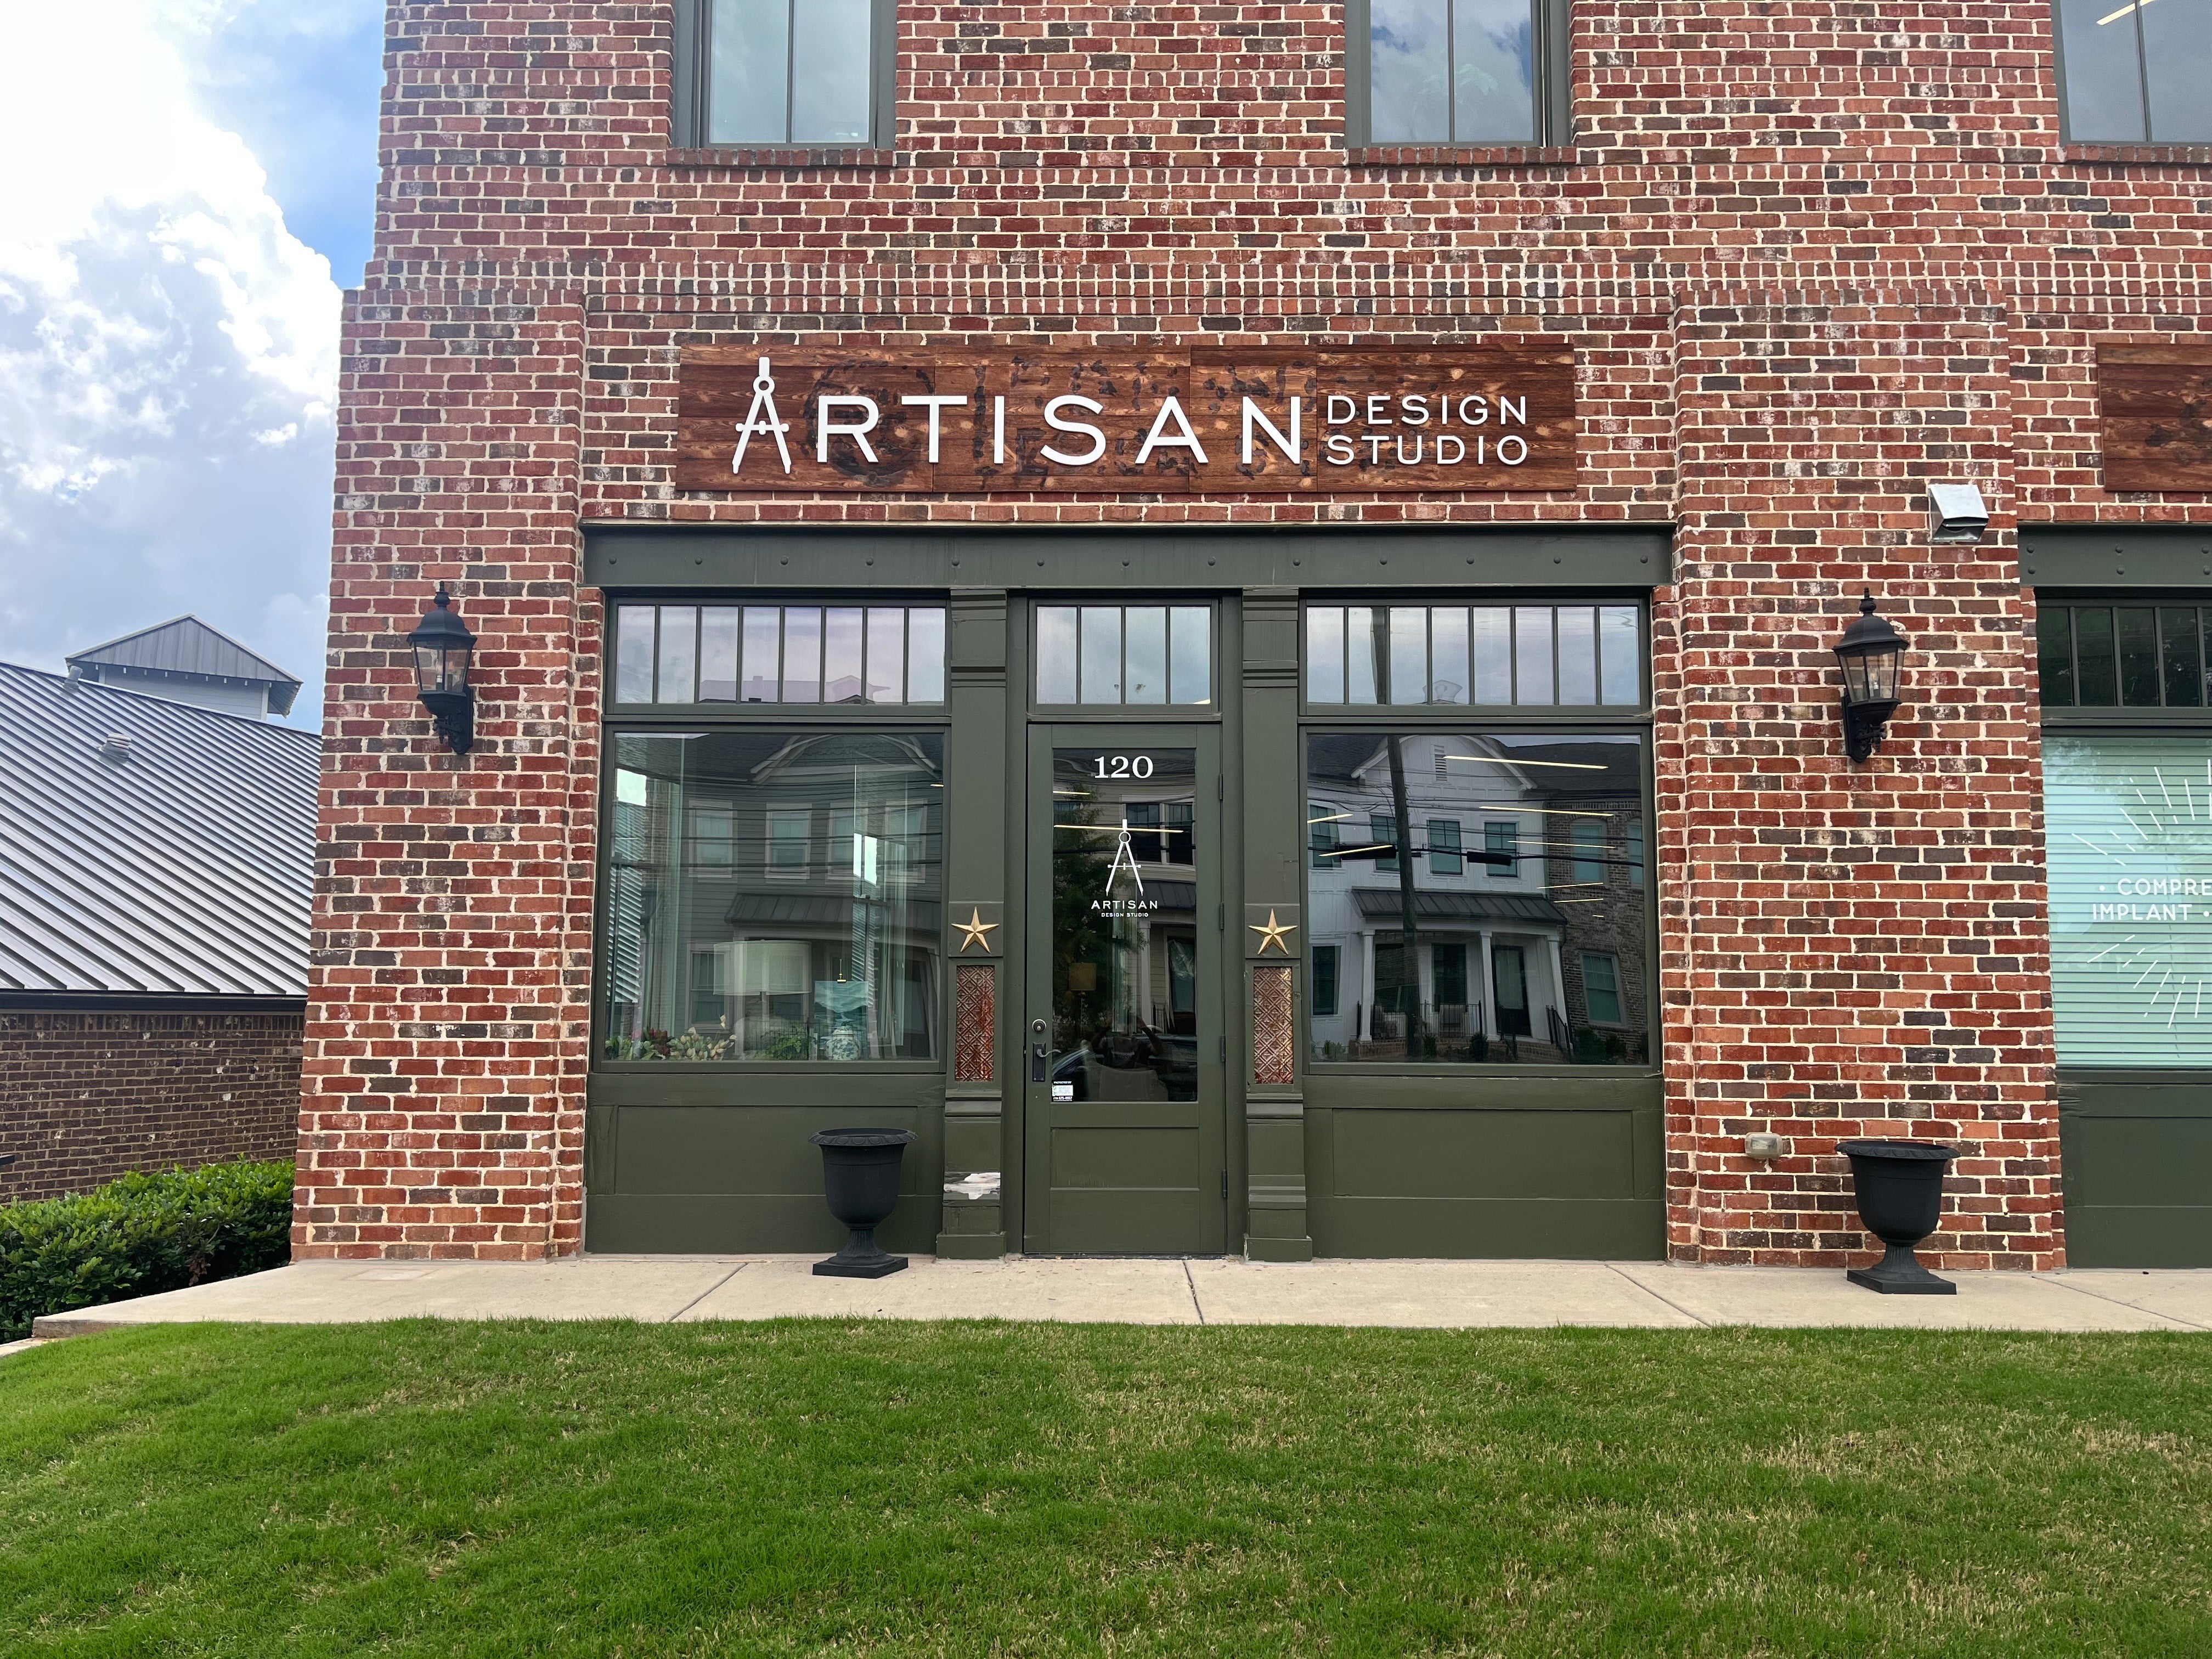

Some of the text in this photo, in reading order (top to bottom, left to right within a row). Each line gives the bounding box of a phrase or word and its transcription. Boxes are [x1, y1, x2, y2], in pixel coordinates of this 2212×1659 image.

[730, 357, 1301, 475] ARTISAN
[1327, 394, 1527, 426] DESIGN
[1326, 435, 1528, 466] STUDIO
[1094, 755, 1154, 779] 120
[2117, 878, 2212, 896] COMPRE
[1091, 900, 1158, 910] ARTISAN
[2092, 903, 2193, 921] IMPLANT
